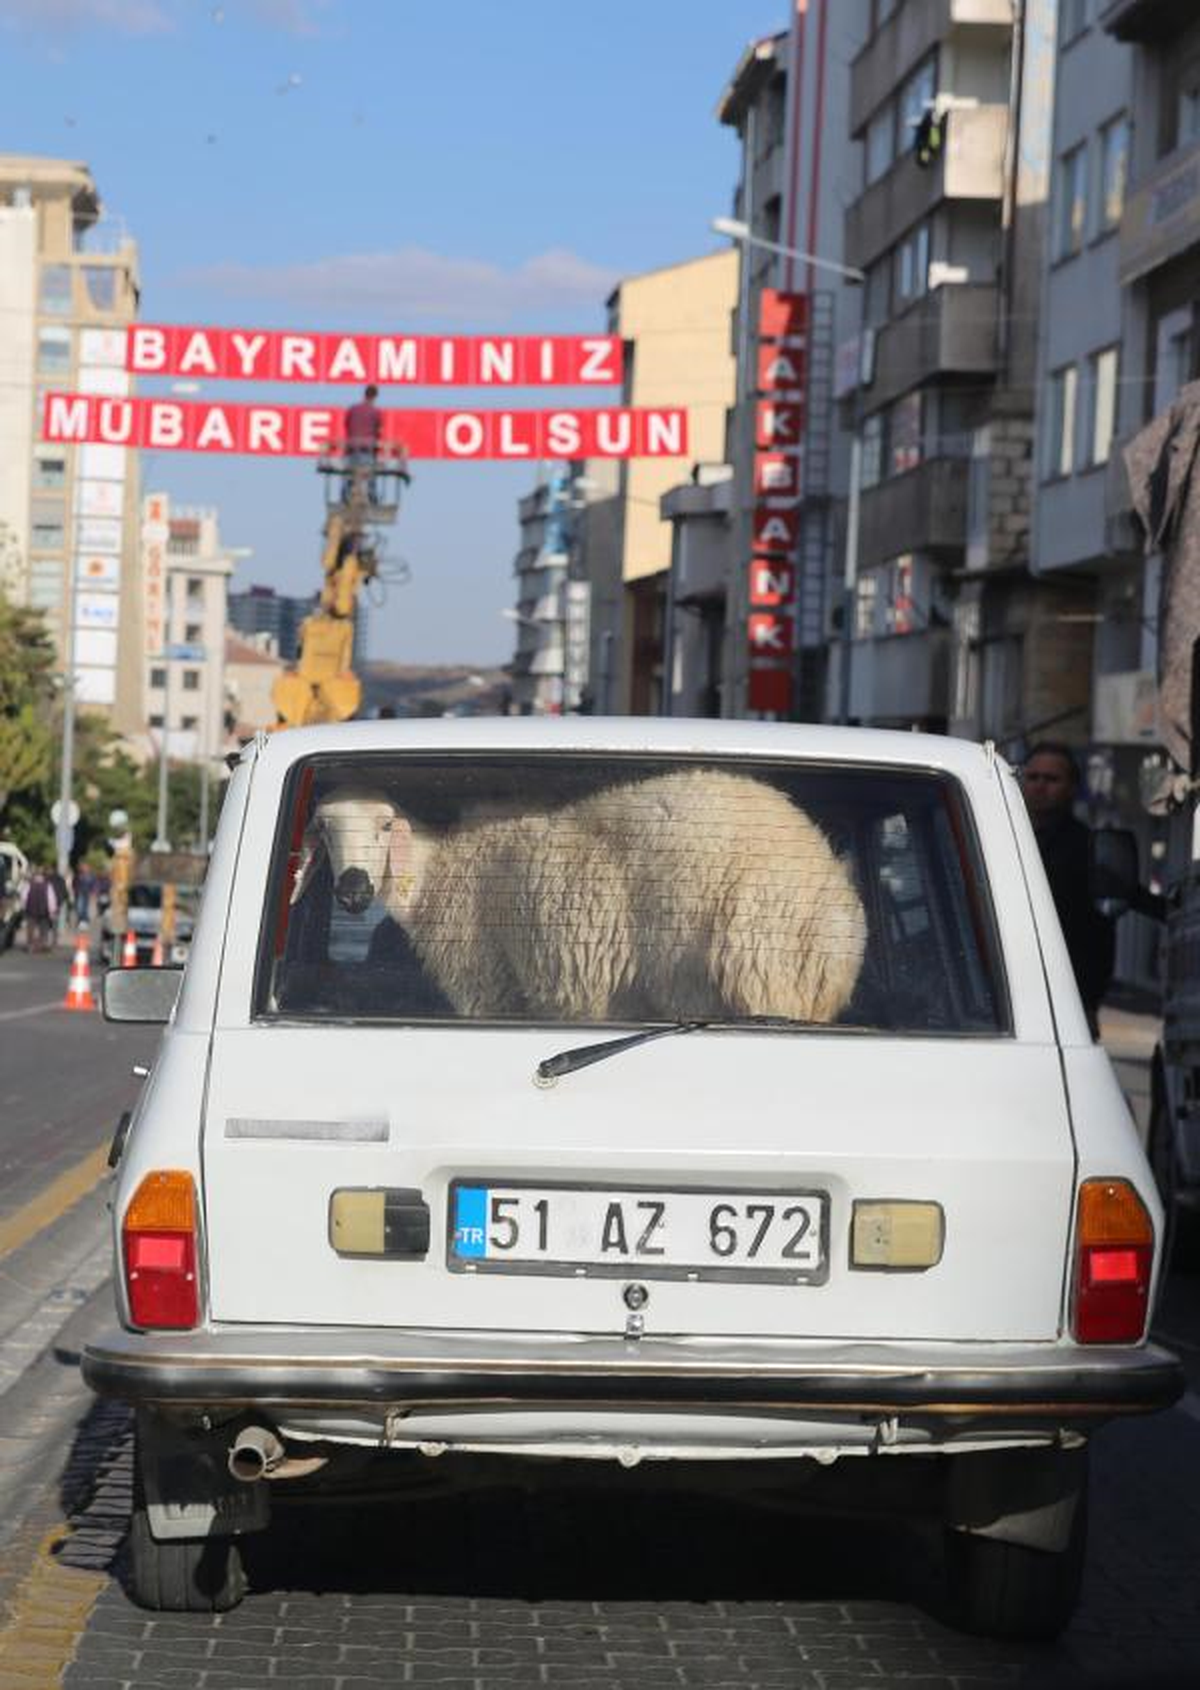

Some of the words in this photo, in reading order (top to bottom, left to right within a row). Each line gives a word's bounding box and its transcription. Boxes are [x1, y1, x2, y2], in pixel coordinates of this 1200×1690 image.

[132, 329, 615, 382] BAYRAMINIZ
[49, 396, 332, 451] MÜBARE
[445, 413, 682, 454] OLSUN
[755, 357, 797, 649] AKBANK
[459, 1227, 484, 1244] TR
[489, 1197, 549, 1250] 51
[601, 1201, 666, 1255] AZ
[709, 1203, 812, 1260] 672
